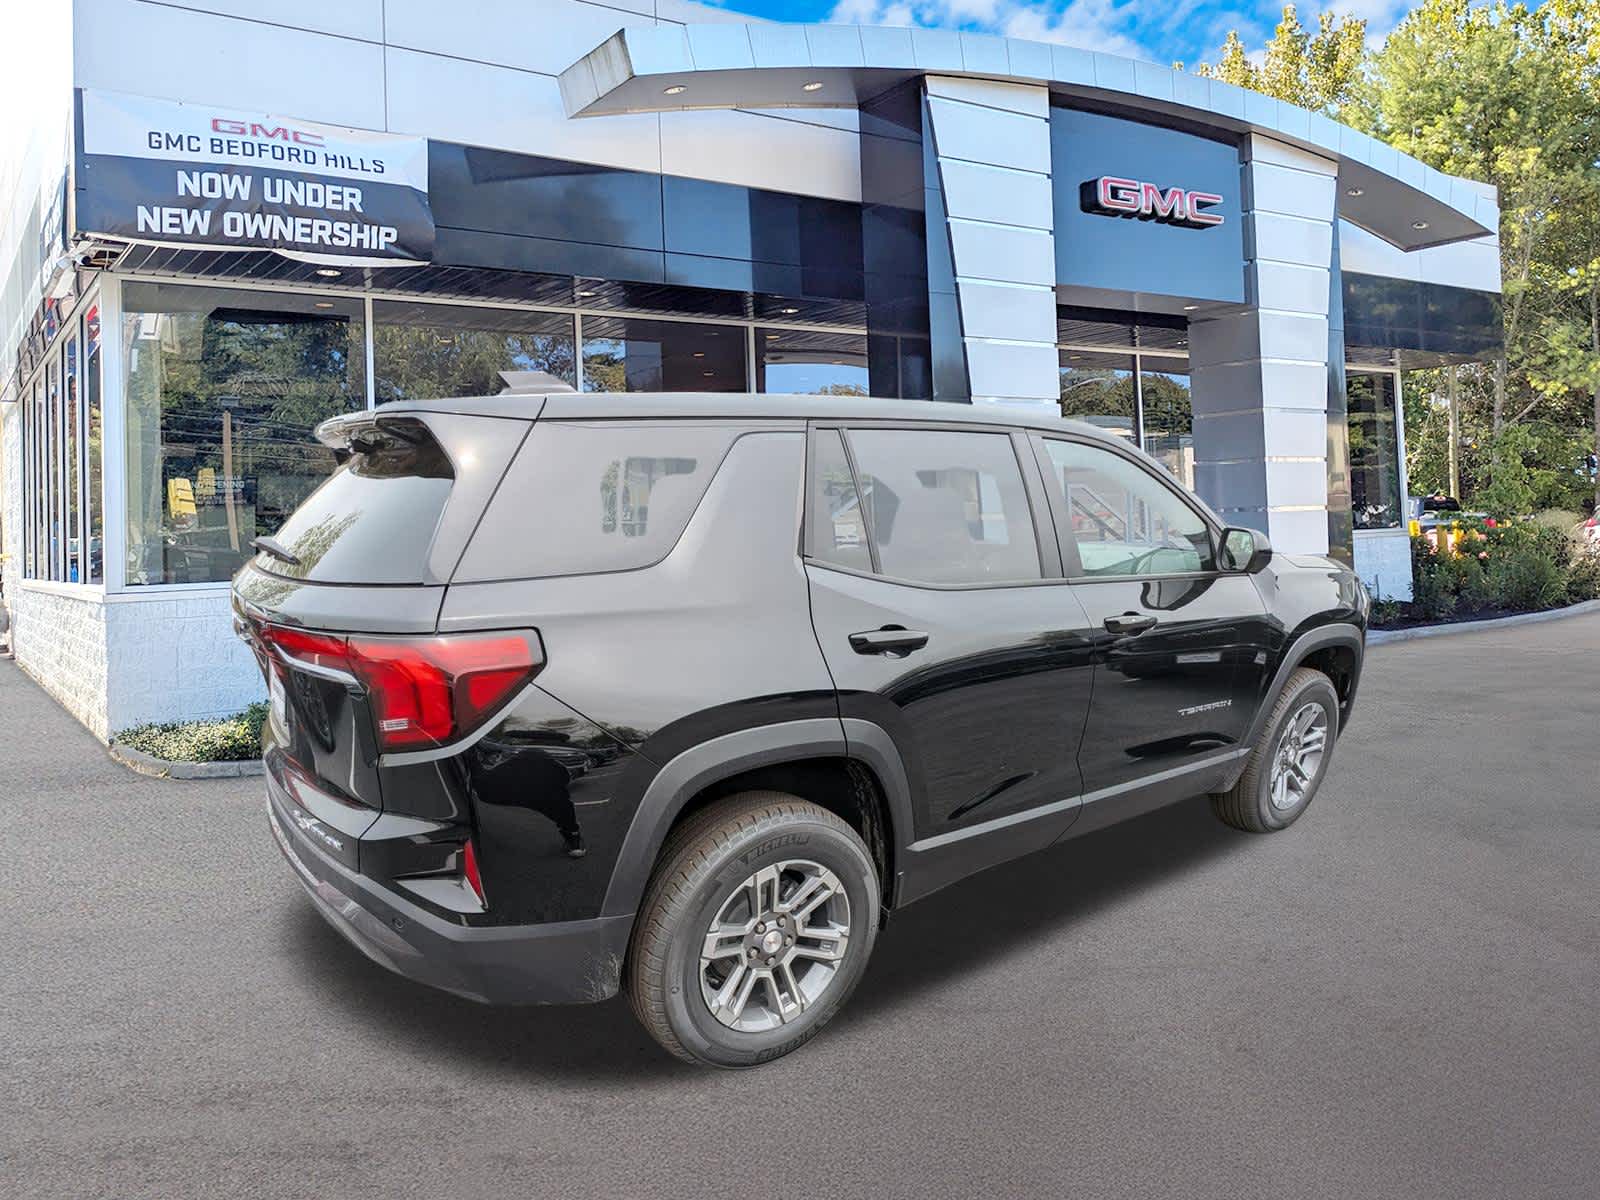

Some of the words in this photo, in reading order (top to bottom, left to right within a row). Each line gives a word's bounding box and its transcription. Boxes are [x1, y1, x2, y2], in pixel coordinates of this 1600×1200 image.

[148, 132, 200, 152] GMC
[210, 138, 316, 165] BEDFORD
[324, 153, 385, 174] HILLS
[211, 118, 326, 147] GMC
[177, 170, 252, 200] NOW
[264, 177, 363, 213] UNDER
[1091, 175, 1225, 226] GMC
[137, 206, 211, 236] NEW
[223, 211, 398, 250] OWNERSHIP
